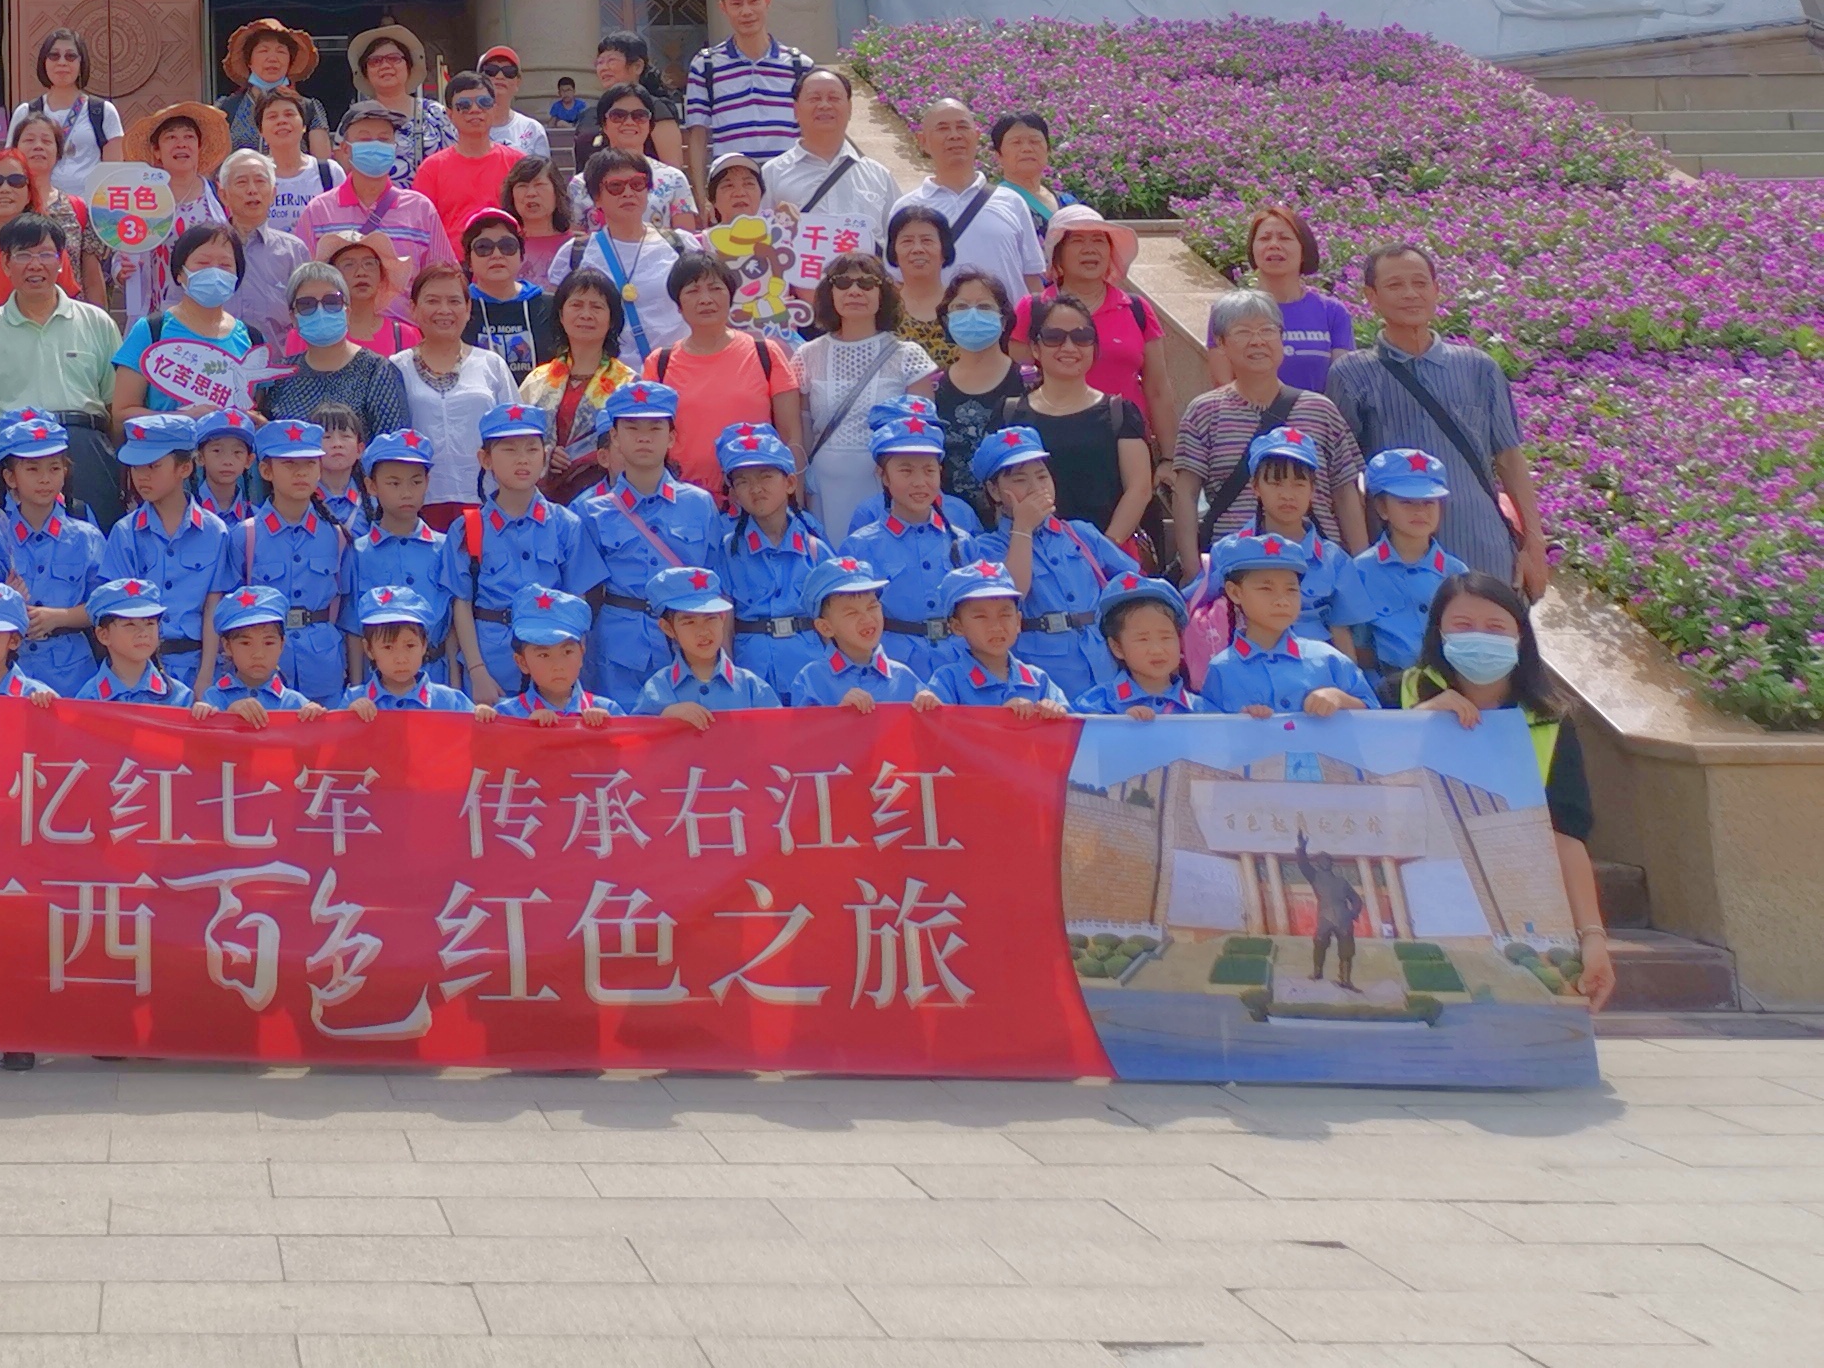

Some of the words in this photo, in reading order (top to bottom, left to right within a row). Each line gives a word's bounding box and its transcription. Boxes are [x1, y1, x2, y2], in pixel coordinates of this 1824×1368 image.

[108, 185, 159, 212] 百色
[123, 220, 137, 239] 3
[802, 226, 860, 253] 千姿
[153, 354, 232, 407] 忆苦思甜
[458, 759, 965, 860] 传承右江红
